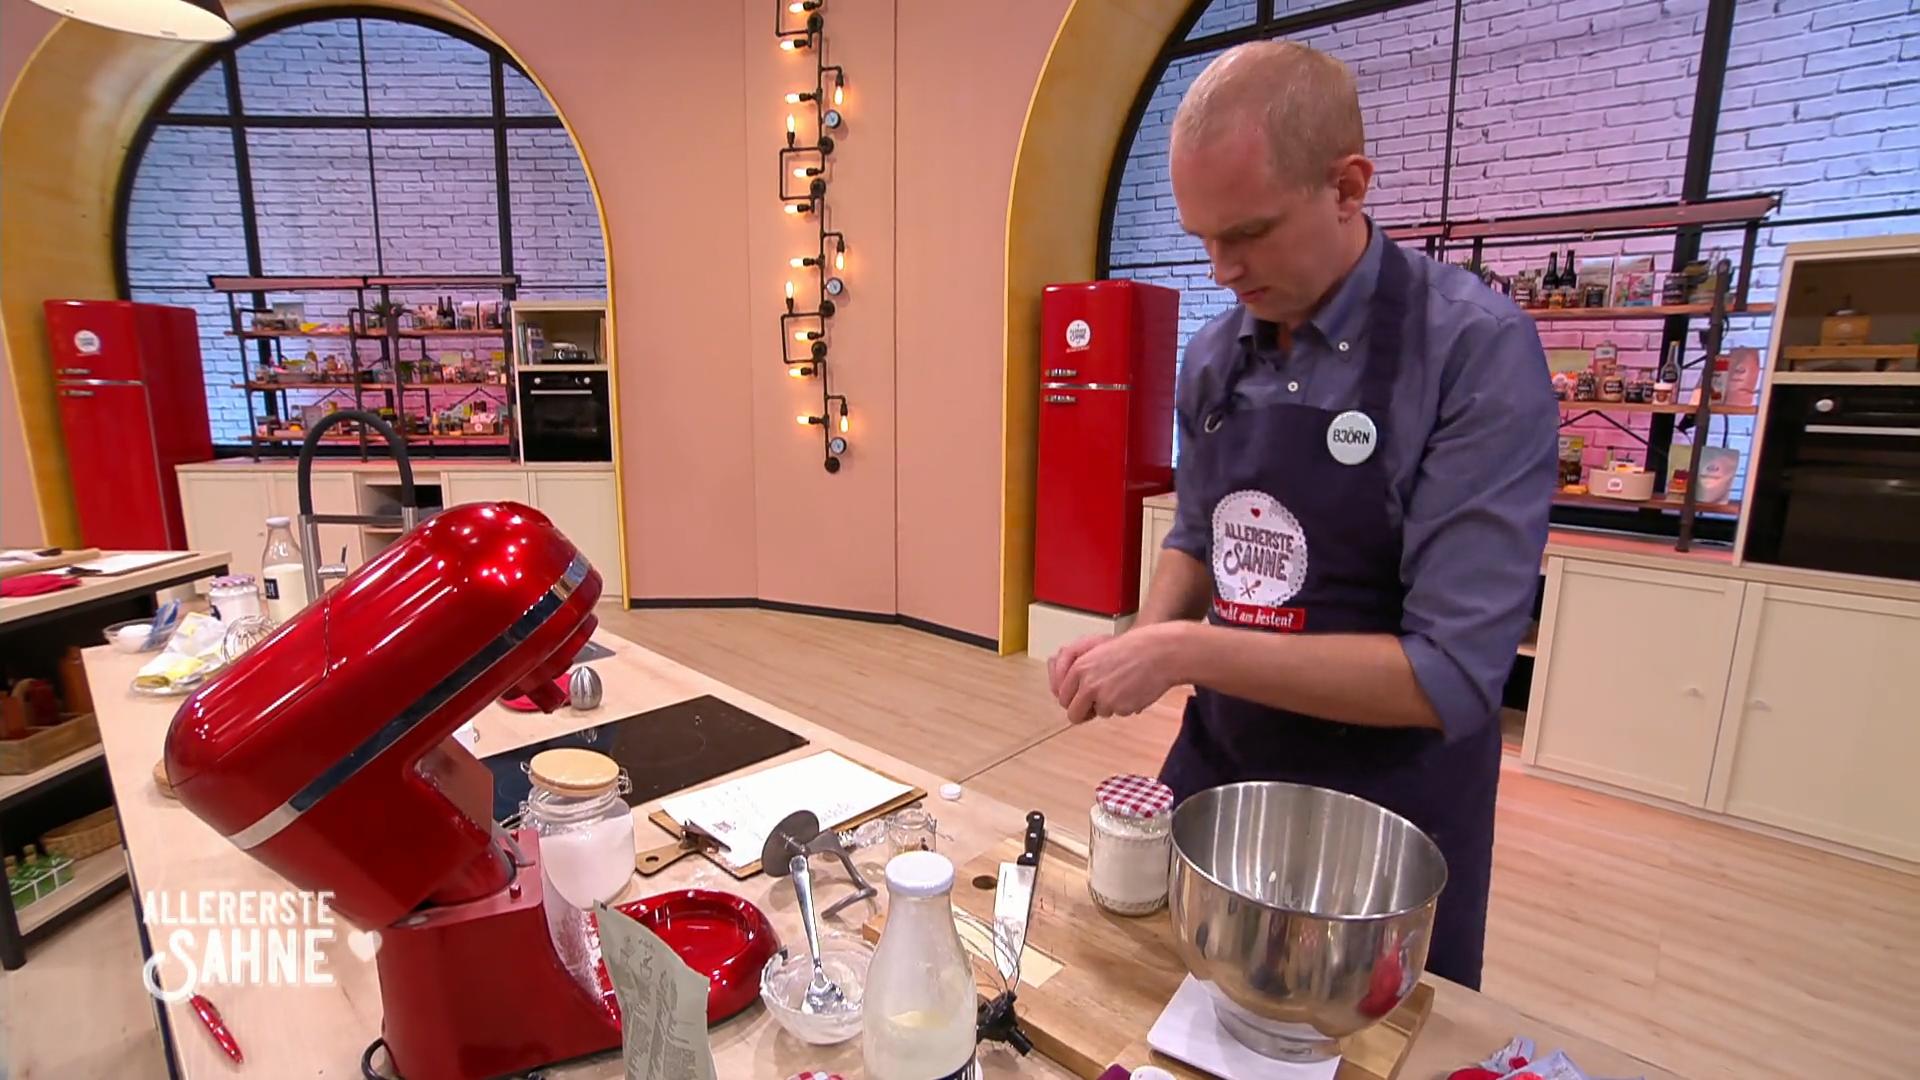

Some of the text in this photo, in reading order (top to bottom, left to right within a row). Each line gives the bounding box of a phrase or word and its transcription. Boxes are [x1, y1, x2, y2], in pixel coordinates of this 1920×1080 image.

[1333, 426, 1370, 445] BJÖRN
[1224, 522, 1295, 554] ALLERERSTE
[1223, 542, 1290, 581] SAHNE
[1255, 607, 1294, 628] besten?
